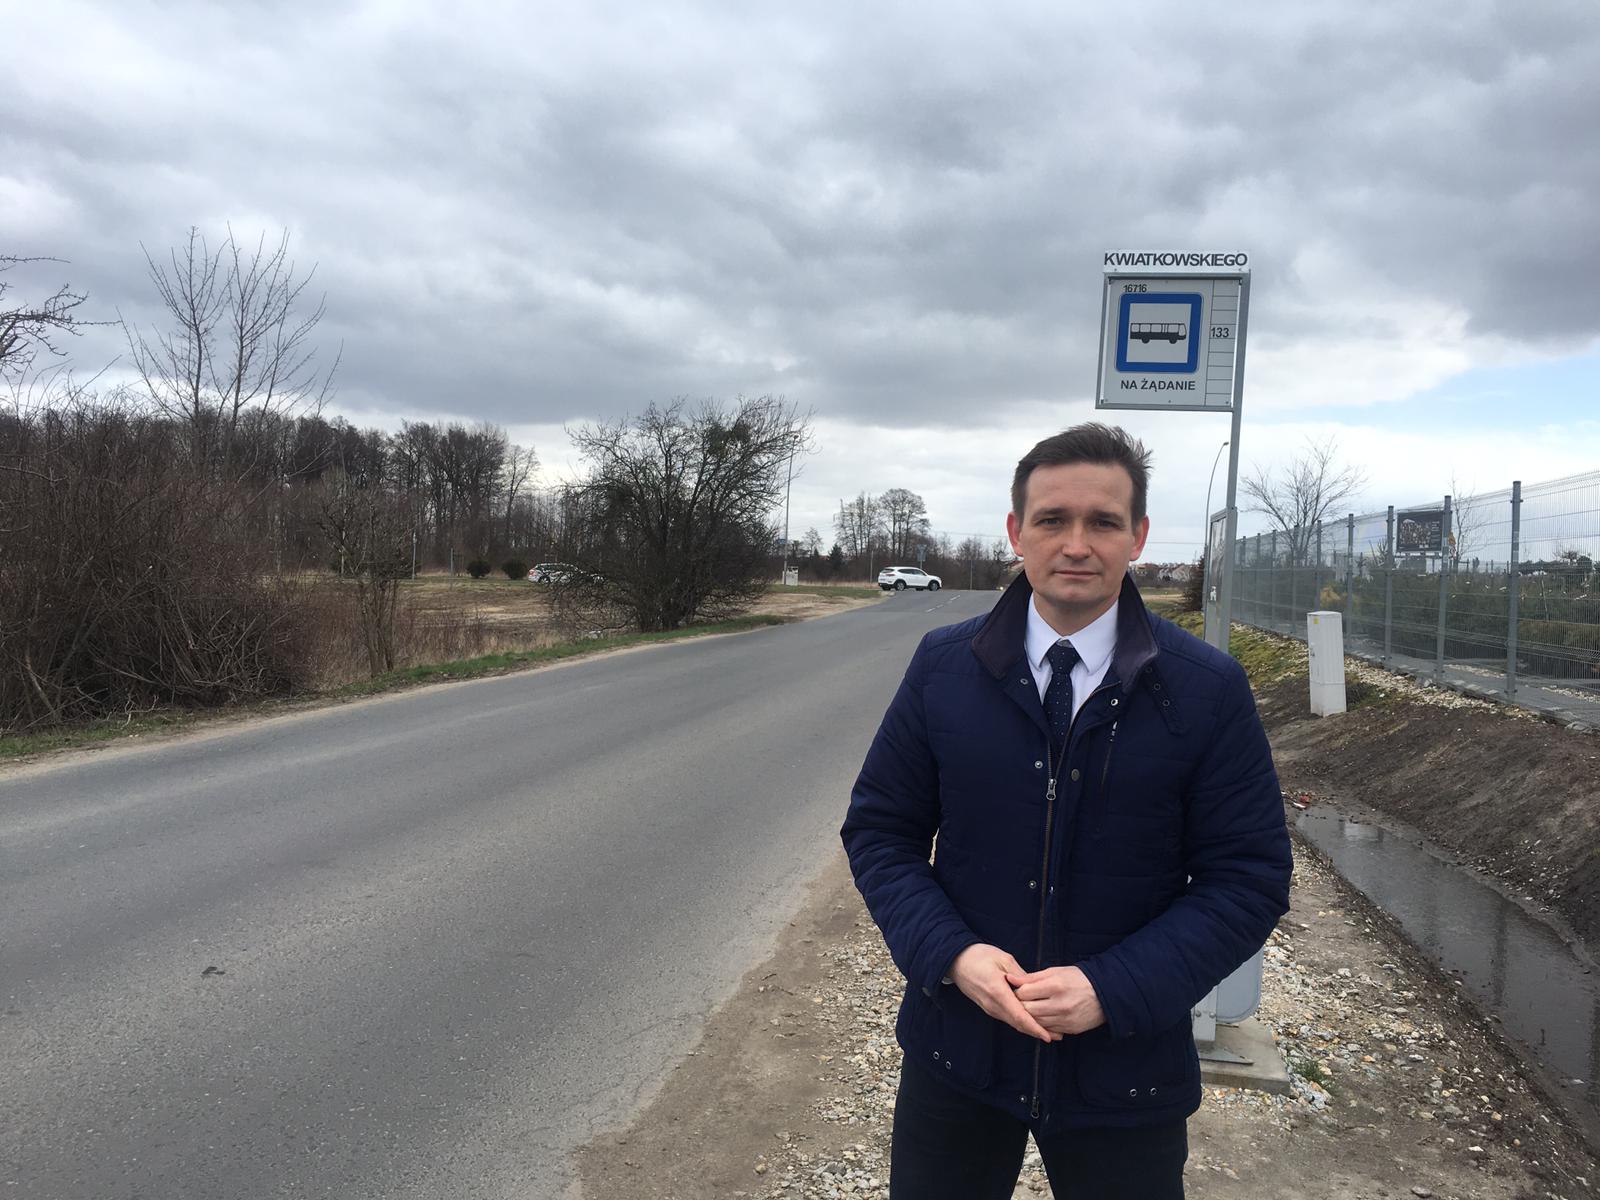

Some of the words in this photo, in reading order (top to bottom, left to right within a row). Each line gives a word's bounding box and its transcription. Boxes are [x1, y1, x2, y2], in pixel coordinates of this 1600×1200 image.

[1104, 252, 1248, 267] KWIATKOWSKIEGO
[1123, 284, 1147, 293] 16716
[1210, 327, 1230, 338] 133
[1120, 380, 1138, 390] NA
[1140, 378, 1196, 392] ŻĄDANIE
